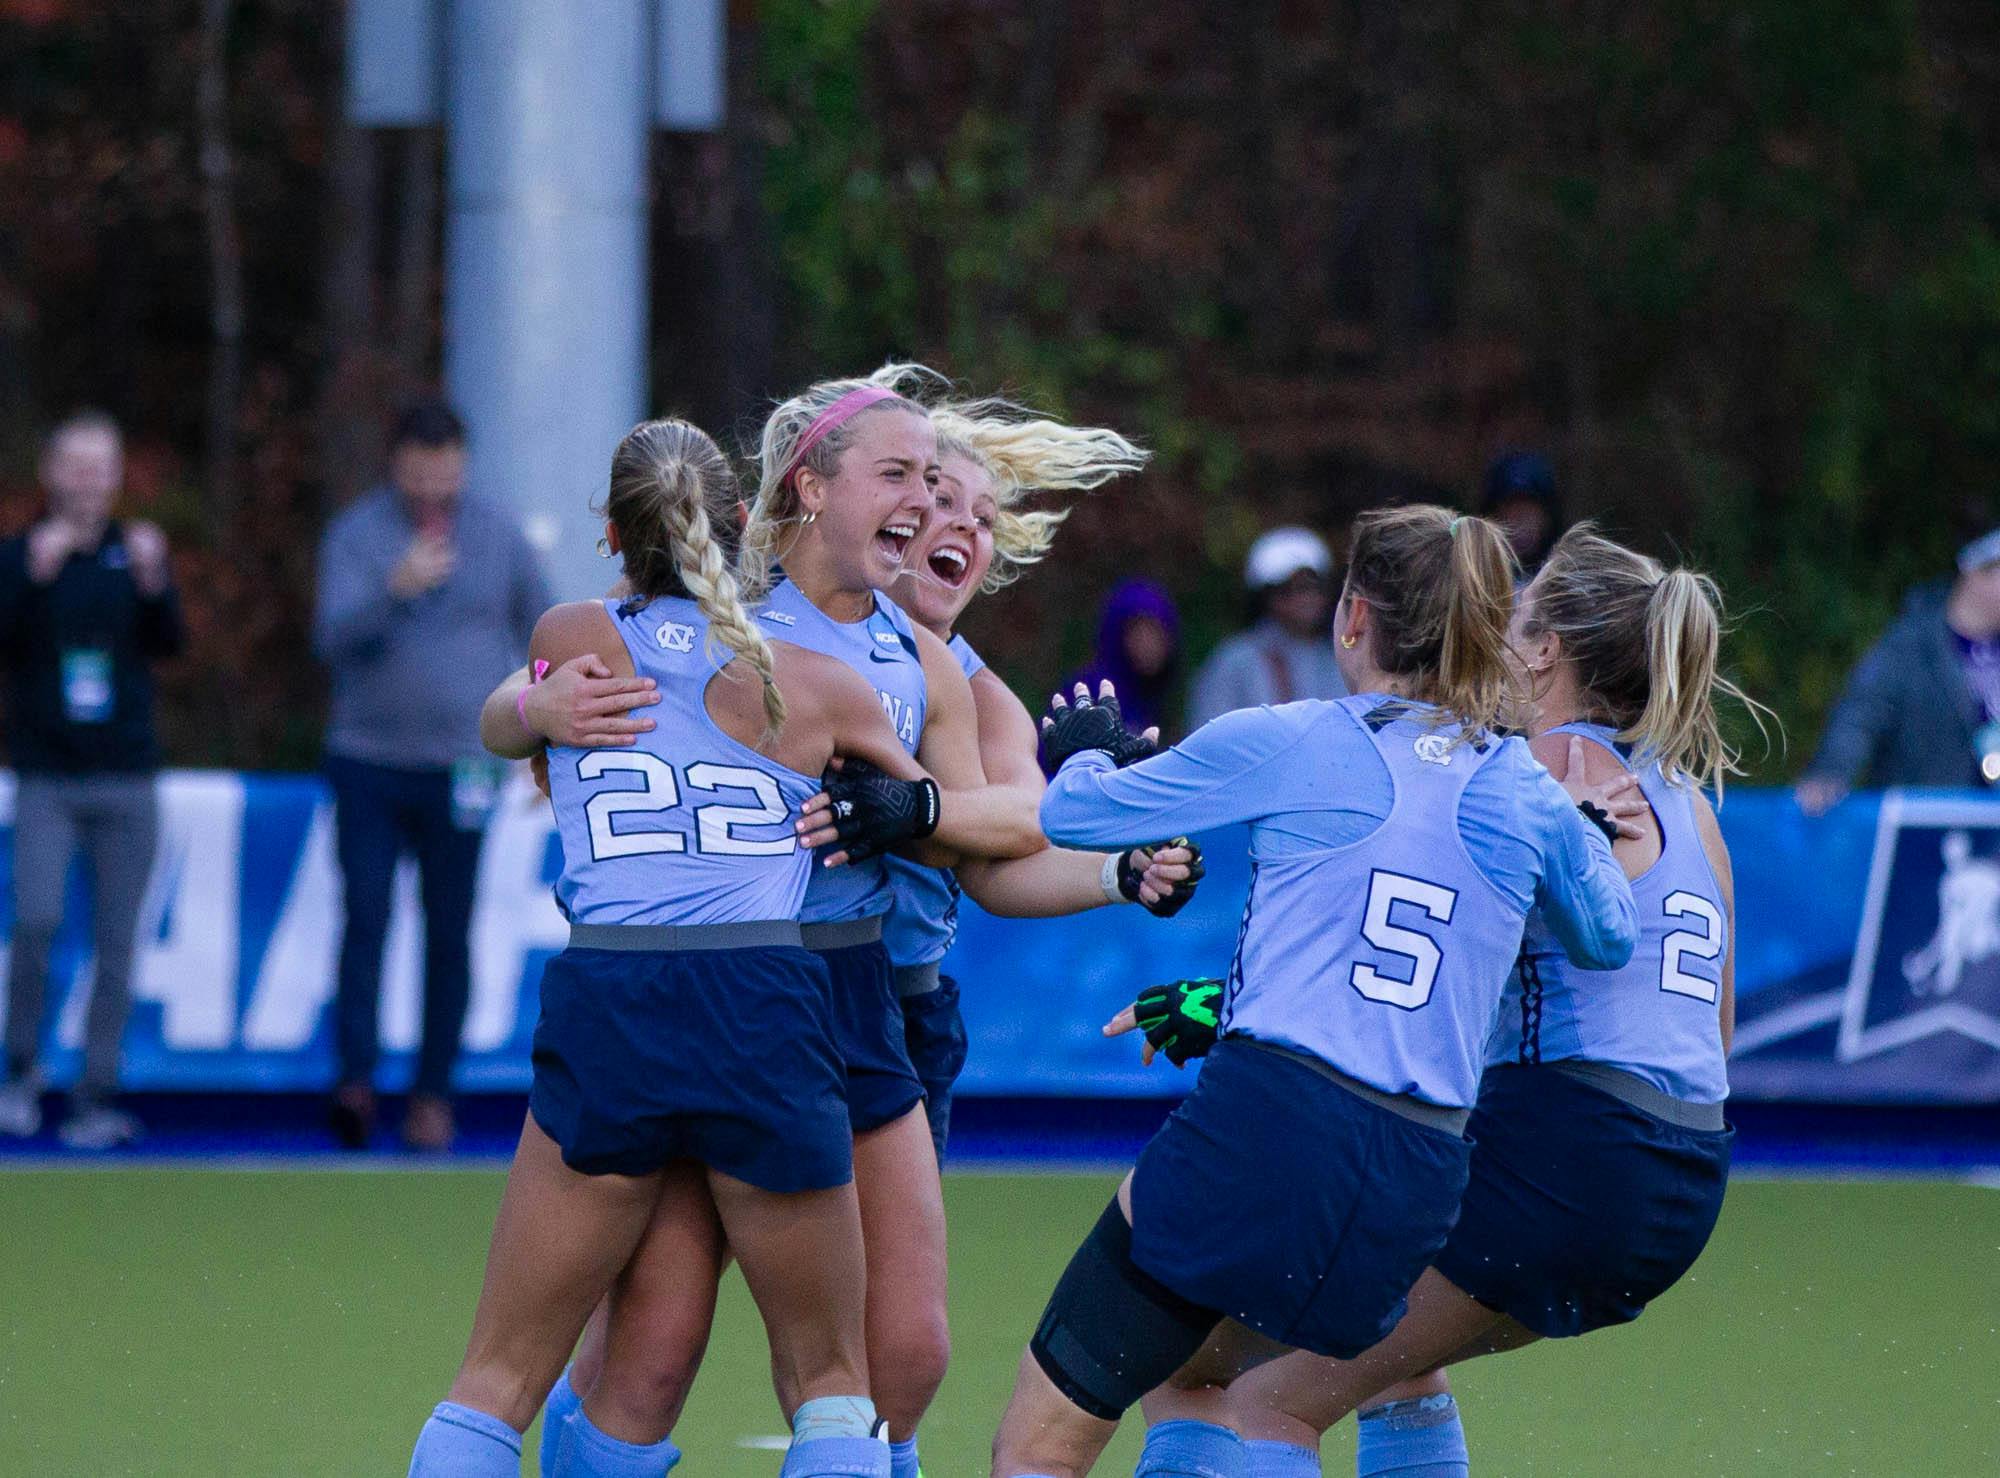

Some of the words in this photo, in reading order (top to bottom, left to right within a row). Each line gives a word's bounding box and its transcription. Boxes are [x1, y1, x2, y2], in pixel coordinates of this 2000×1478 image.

[760, 610, 797, 627] ACC
[576, 750, 798, 862] 22
[1349, 867, 1459, 1012] 5
[1660, 889, 1722, 1005] 2
